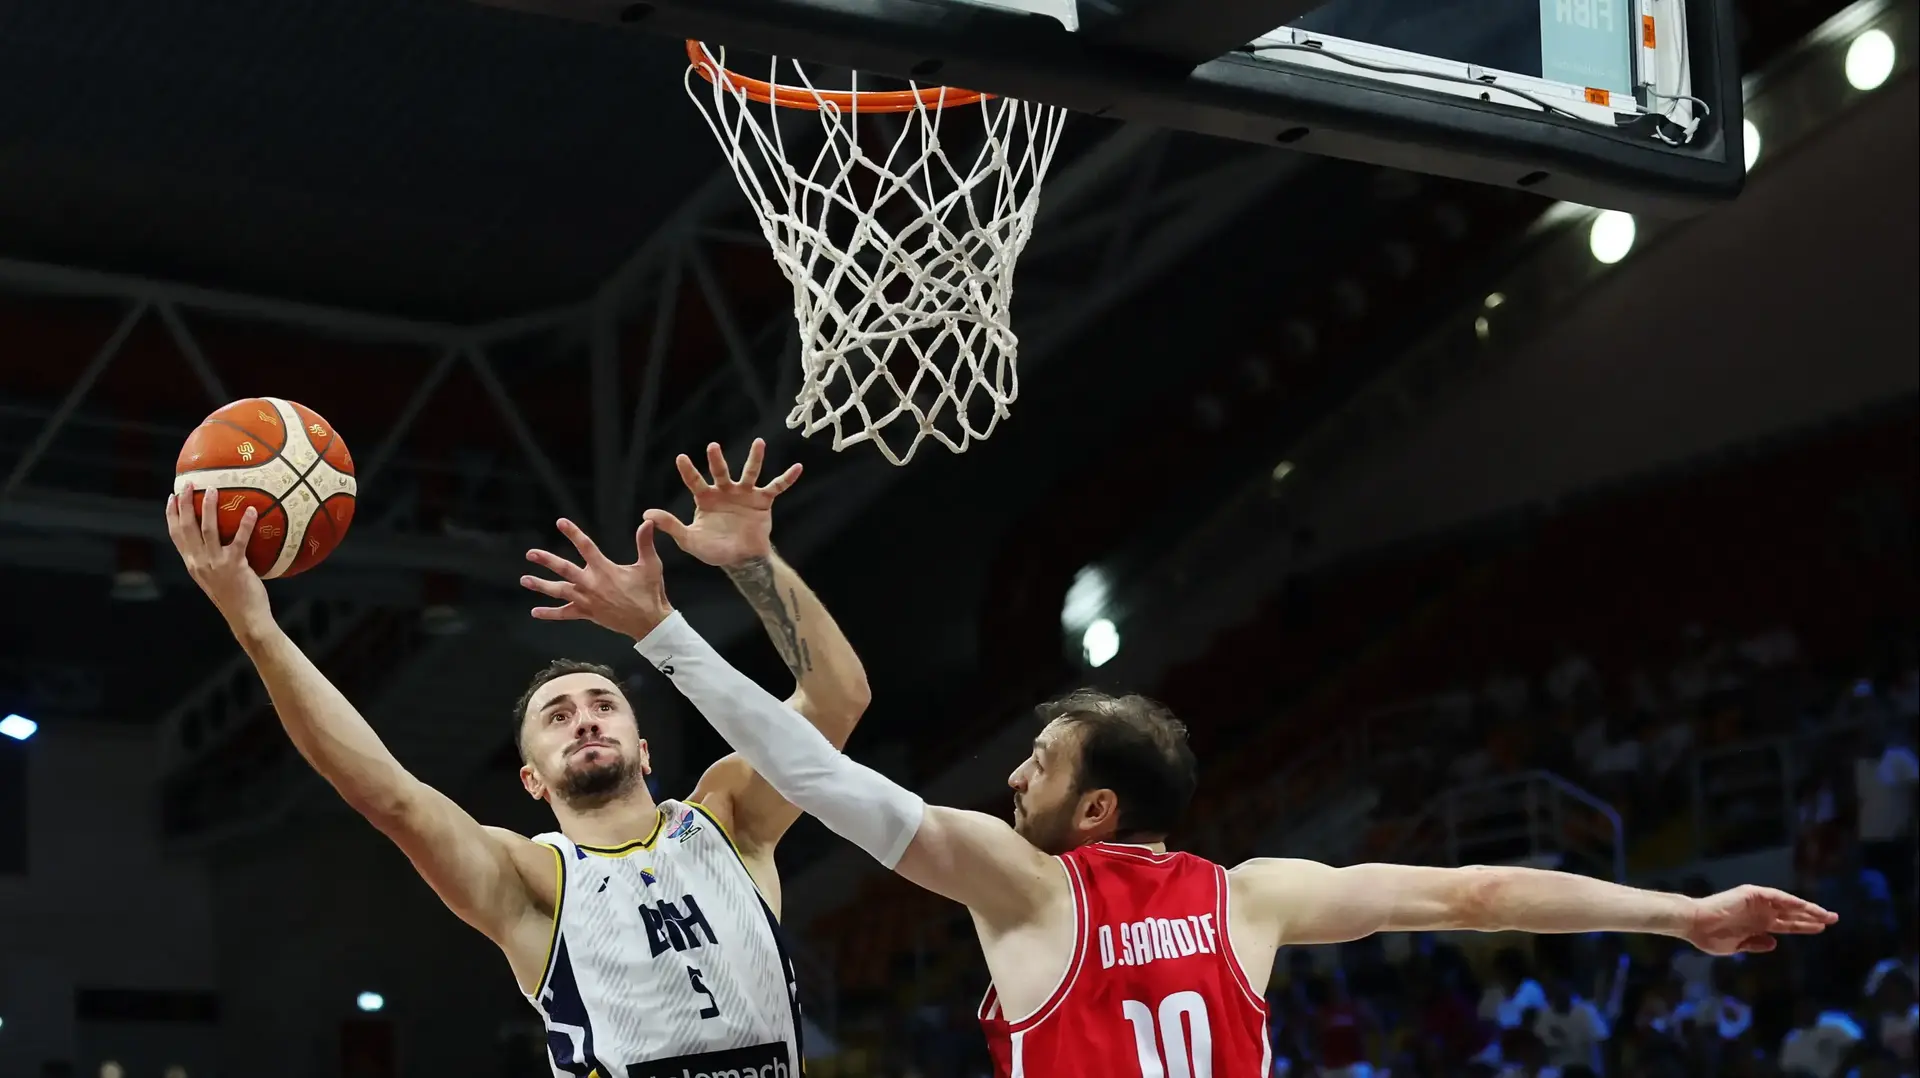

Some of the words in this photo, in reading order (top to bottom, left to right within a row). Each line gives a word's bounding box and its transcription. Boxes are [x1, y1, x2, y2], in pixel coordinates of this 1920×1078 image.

[686, 965, 720, 1020] 5
[1121, 990, 1213, 1078] 10
[649, 1056, 788, 1078] mach
